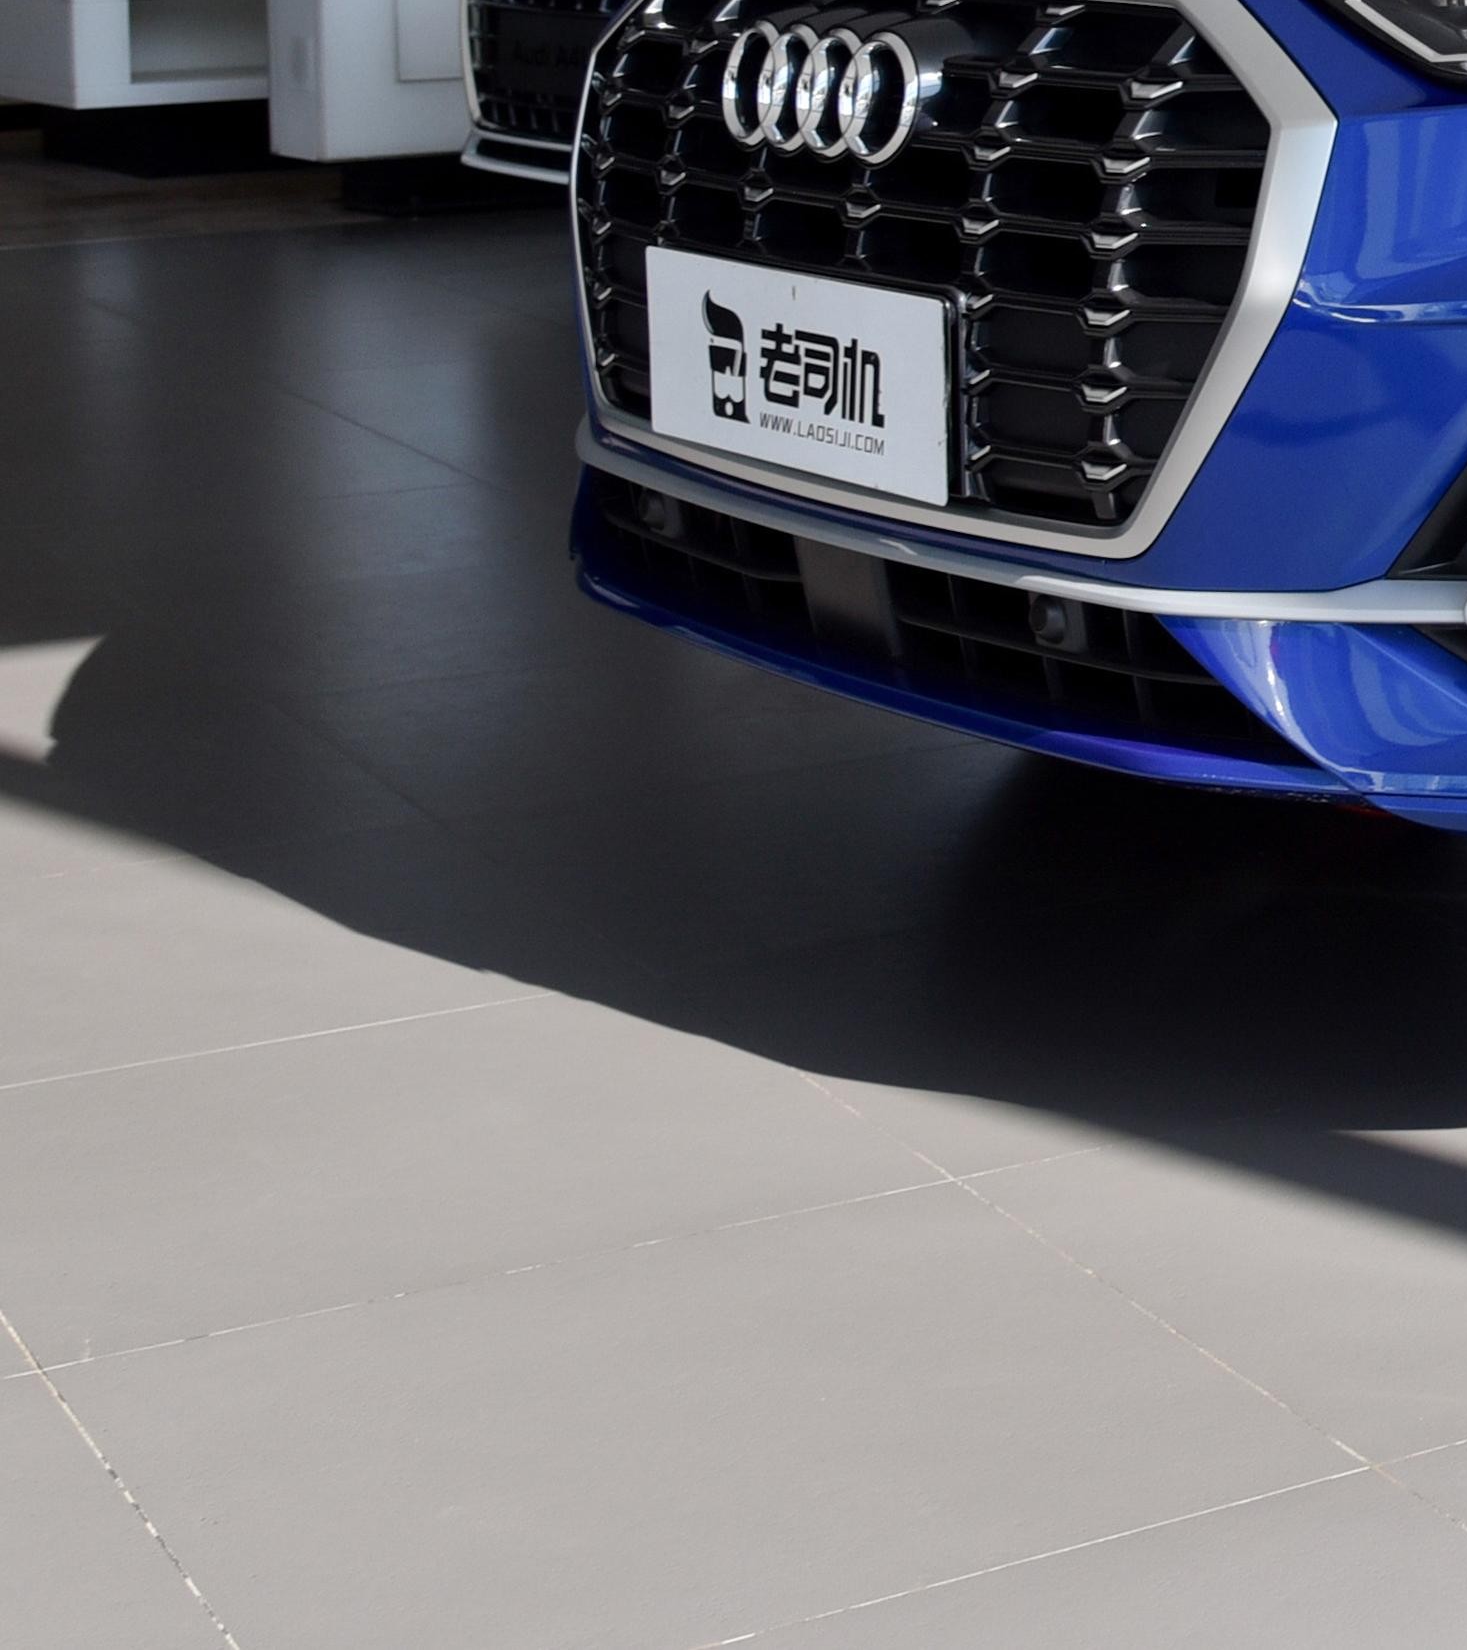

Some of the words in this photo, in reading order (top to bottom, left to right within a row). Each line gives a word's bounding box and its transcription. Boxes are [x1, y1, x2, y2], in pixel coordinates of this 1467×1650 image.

[758, 322, 887, 429] 老司机
[758, 411, 887, 457] WWW.LAOSIJI.COM
